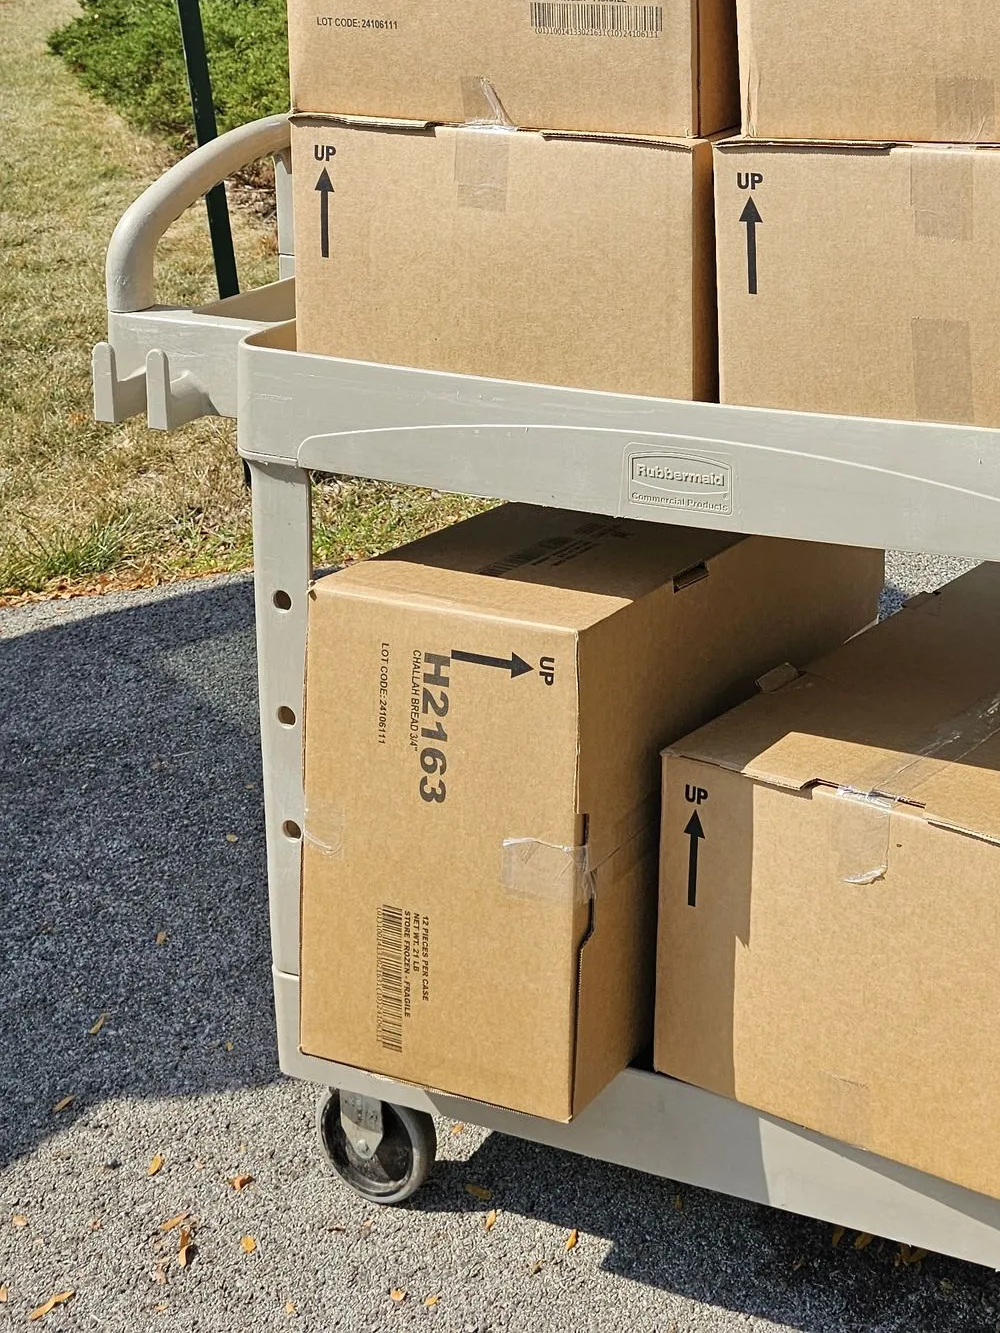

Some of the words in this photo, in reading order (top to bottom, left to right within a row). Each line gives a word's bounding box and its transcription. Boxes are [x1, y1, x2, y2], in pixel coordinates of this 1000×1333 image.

[316, 17, 332, 27] LOT
[334, 18, 361, 28] CODE:
[361, 19, 398, 30] 24106111
[314, 144, 337, 162] UP
[736, 172, 763, 190] UP
[637, 464, 725, 487] Rubbermaid
[631, 491, 685, 507] Commercial
[687, 499, 729, 513] Products
[380, 642, 390, 664] LOT
[411, 649, 421, 695] CHALLAH
[539, 656, 555, 686] UP
[379, 666, 389, 699] CODE:
[378, 699, 387, 745] 24106111
[410, 697, 419, 732] BREAD
[419, 651, 451, 804] H2163
[409, 732, 418, 751] 3/4"
[684, 784, 709, 805] UP
[423, 916, 430, 925] 12
[412, 949, 419, 958] 21
[412, 961, 420, 972] LB
